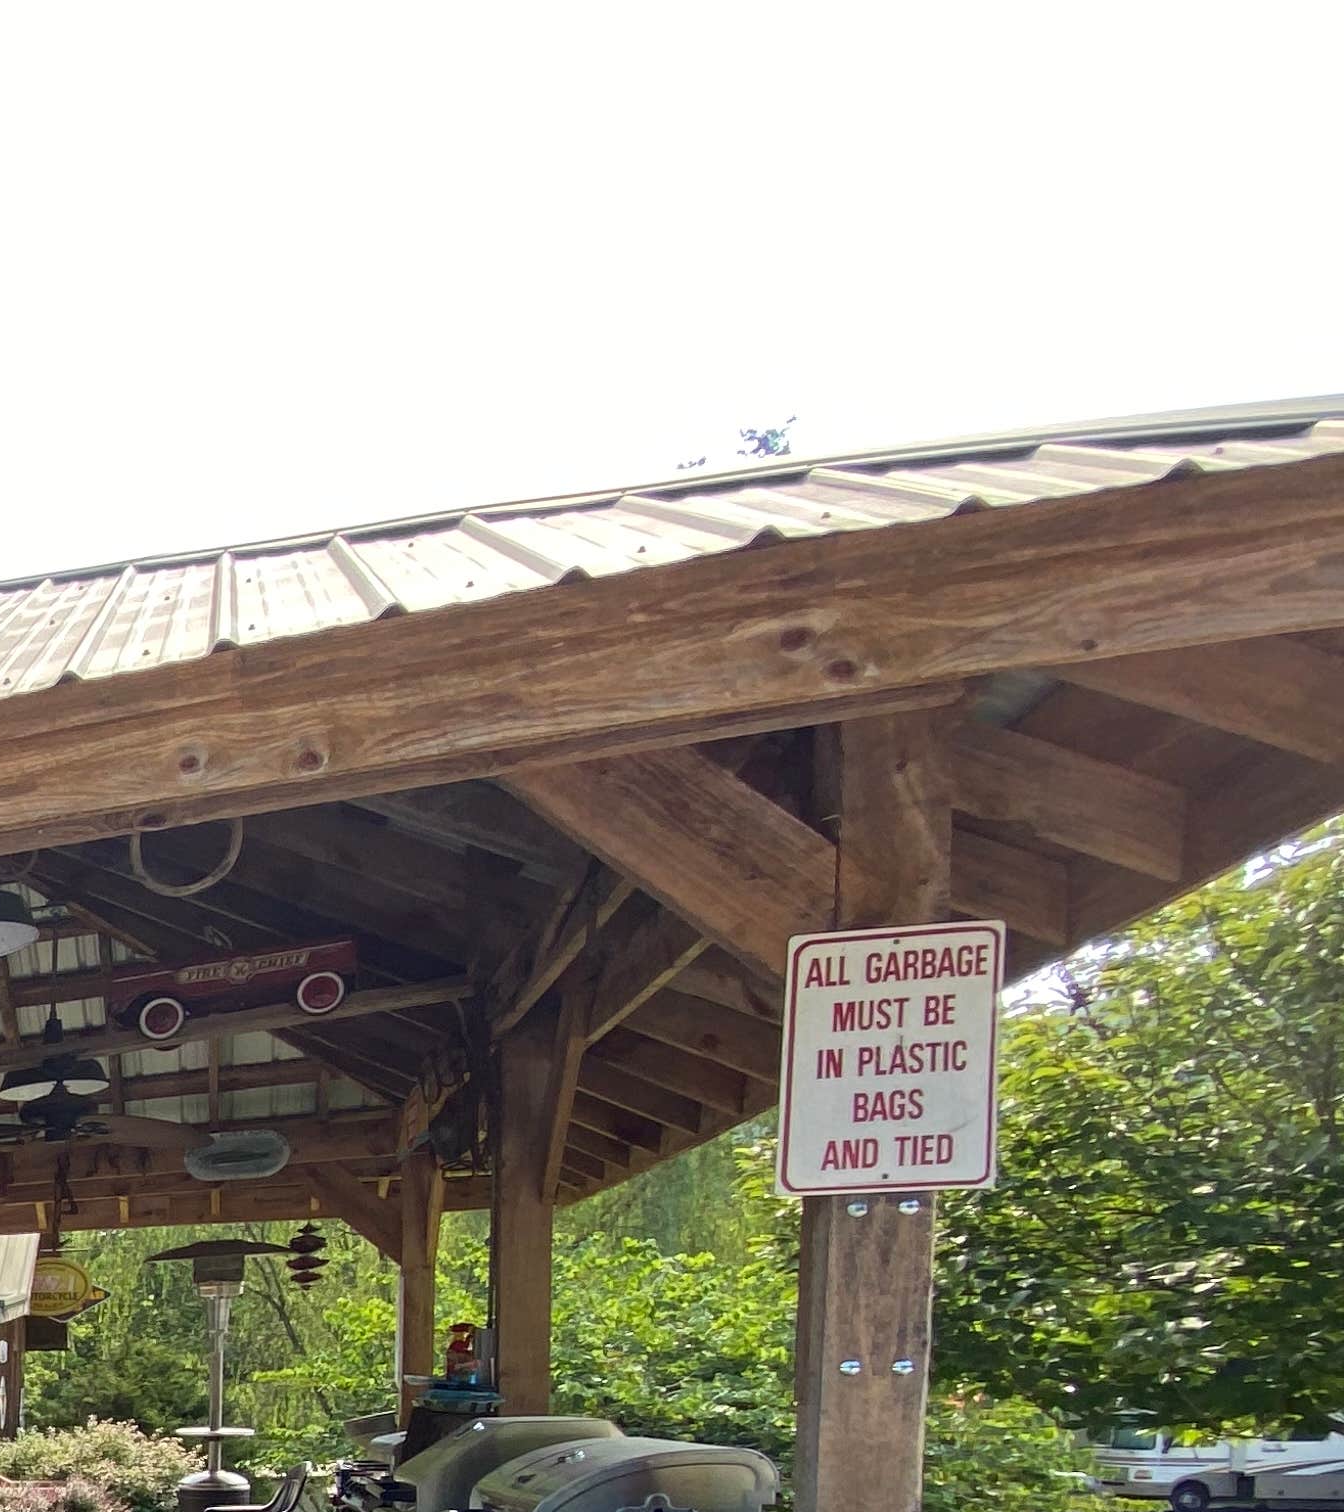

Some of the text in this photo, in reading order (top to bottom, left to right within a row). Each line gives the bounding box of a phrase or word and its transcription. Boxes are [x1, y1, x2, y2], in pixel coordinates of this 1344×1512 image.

[187, 955, 302, 981] FIRE CHIEF
[804, 944, 989, 989] ALL GARBAGE
[831, 994, 957, 1033] MUST BE
[816, 1039, 968, 1080] IN PLASTIC
[852, 1088, 925, 1123] BAGS
[820, 1133, 954, 1171] AND TIED
